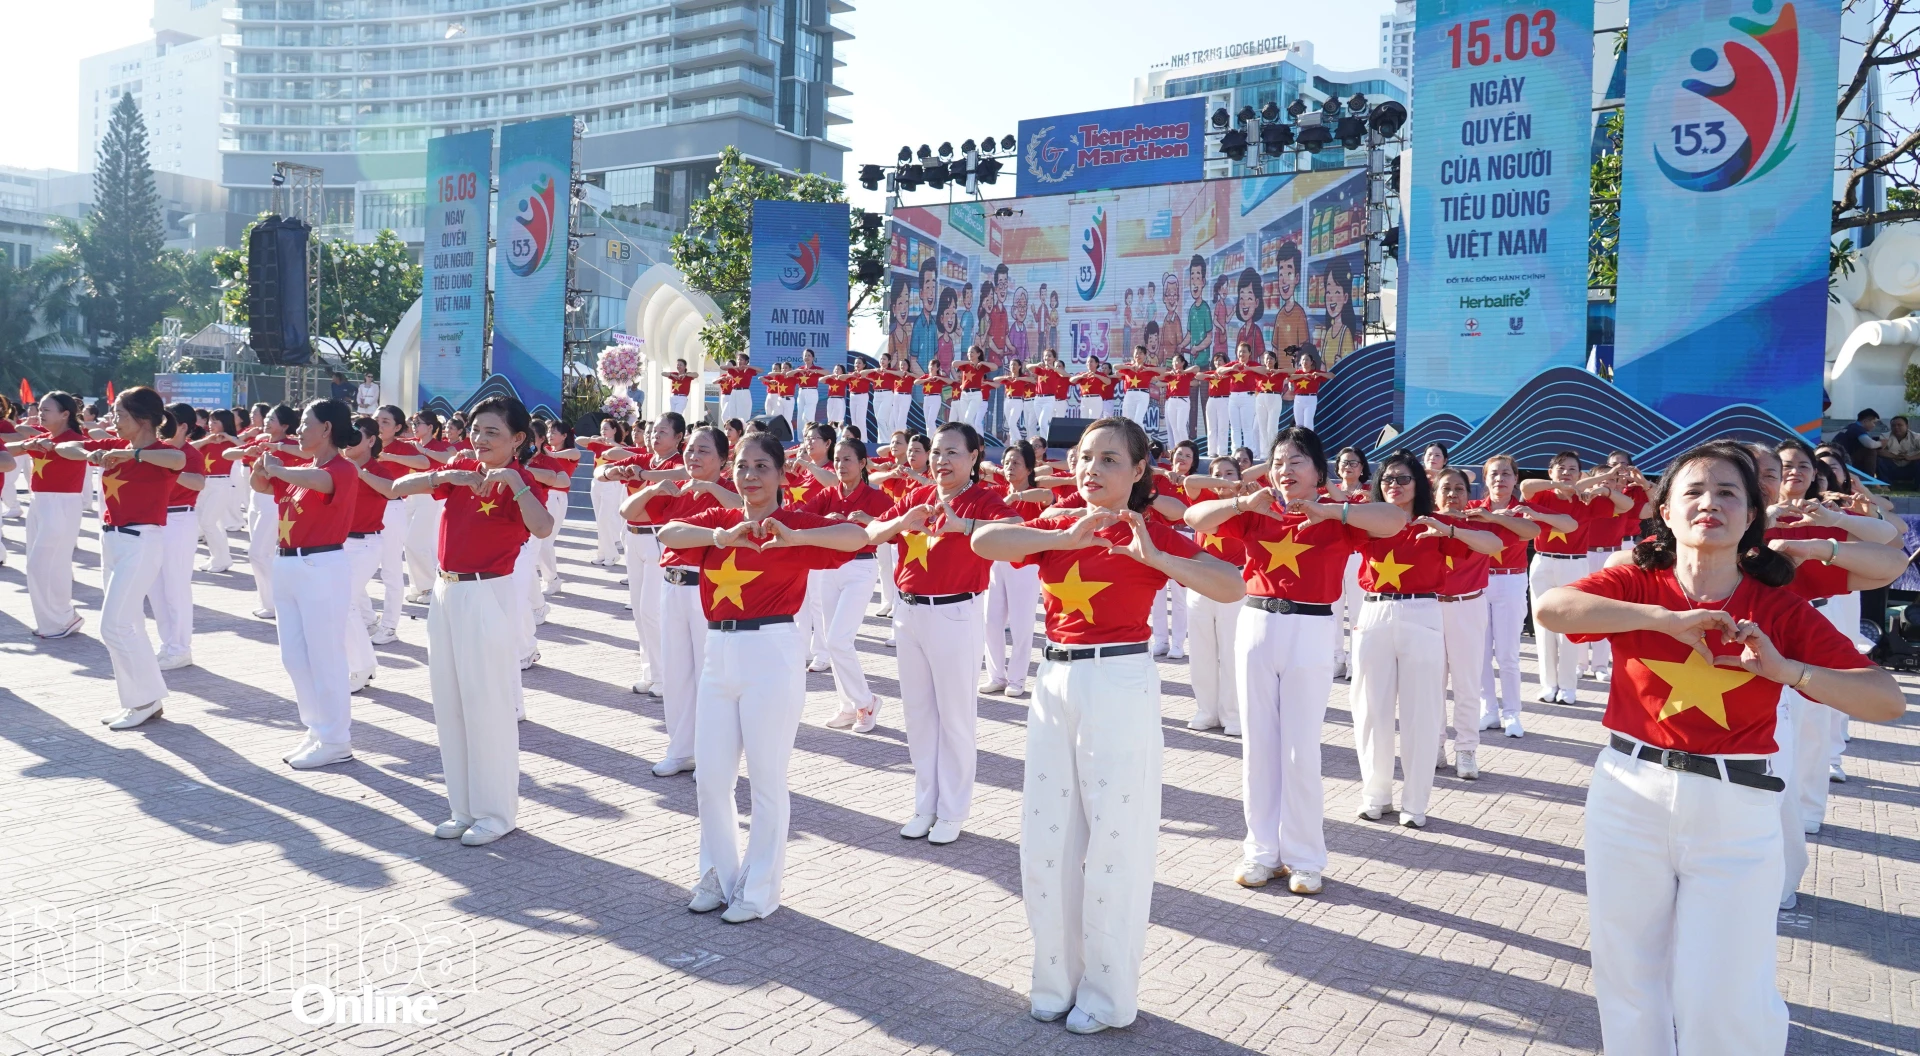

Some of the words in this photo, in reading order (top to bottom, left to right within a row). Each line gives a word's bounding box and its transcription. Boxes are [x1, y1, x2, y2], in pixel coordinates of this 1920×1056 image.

[1447, 9, 1556, 69] 15.03
[1171, 52, 1190, 68] NHA
[1192, 47, 1222, 64] TRANG
[1225, 41, 1255, 59] LODGE
[1257, 35, 1288, 54] HOTEL
[1470, 75, 1526, 108] NGÀY
[1461, 111, 1531, 146] QUYỀN
[1077, 142, 1189, 168] Marathon
[1441, 155, 1481, 185] CỦA
[1487, 148, 1552, 181] NGƯỜI
[437, 172, 477, 203] 15.03
[1440, 192, 1486, 222] TIÊU
[1492, 188, 1550, 218] DÙNG
[445, 208, 466, 226] NGÀY
[1446, 229, 1492, 261] VIỆT
[1498, 228, 1547, 256] NAM
[433, 252, 449, 269] CỦA
[450, 250, 474, 268] NGƯỜI
[433, 273, 450, 290] TIÊU
[451, 272, 472, 289] DÙNG
[1446, 276, 1459, 284] ĐỐI
[435, 295, 452, 313] VIỆT
[453, 295, 471, 311] NAM
[1459, 293, 1524, 309] Herbalife
[771, 308, 788, 324] AN
[791, 307, 824, 325] TOÀN
[438, 332, 462, 341] Herbalife
[764, 329, 807, 347] THÔNG
[809, 332, 830, 348] TIN
